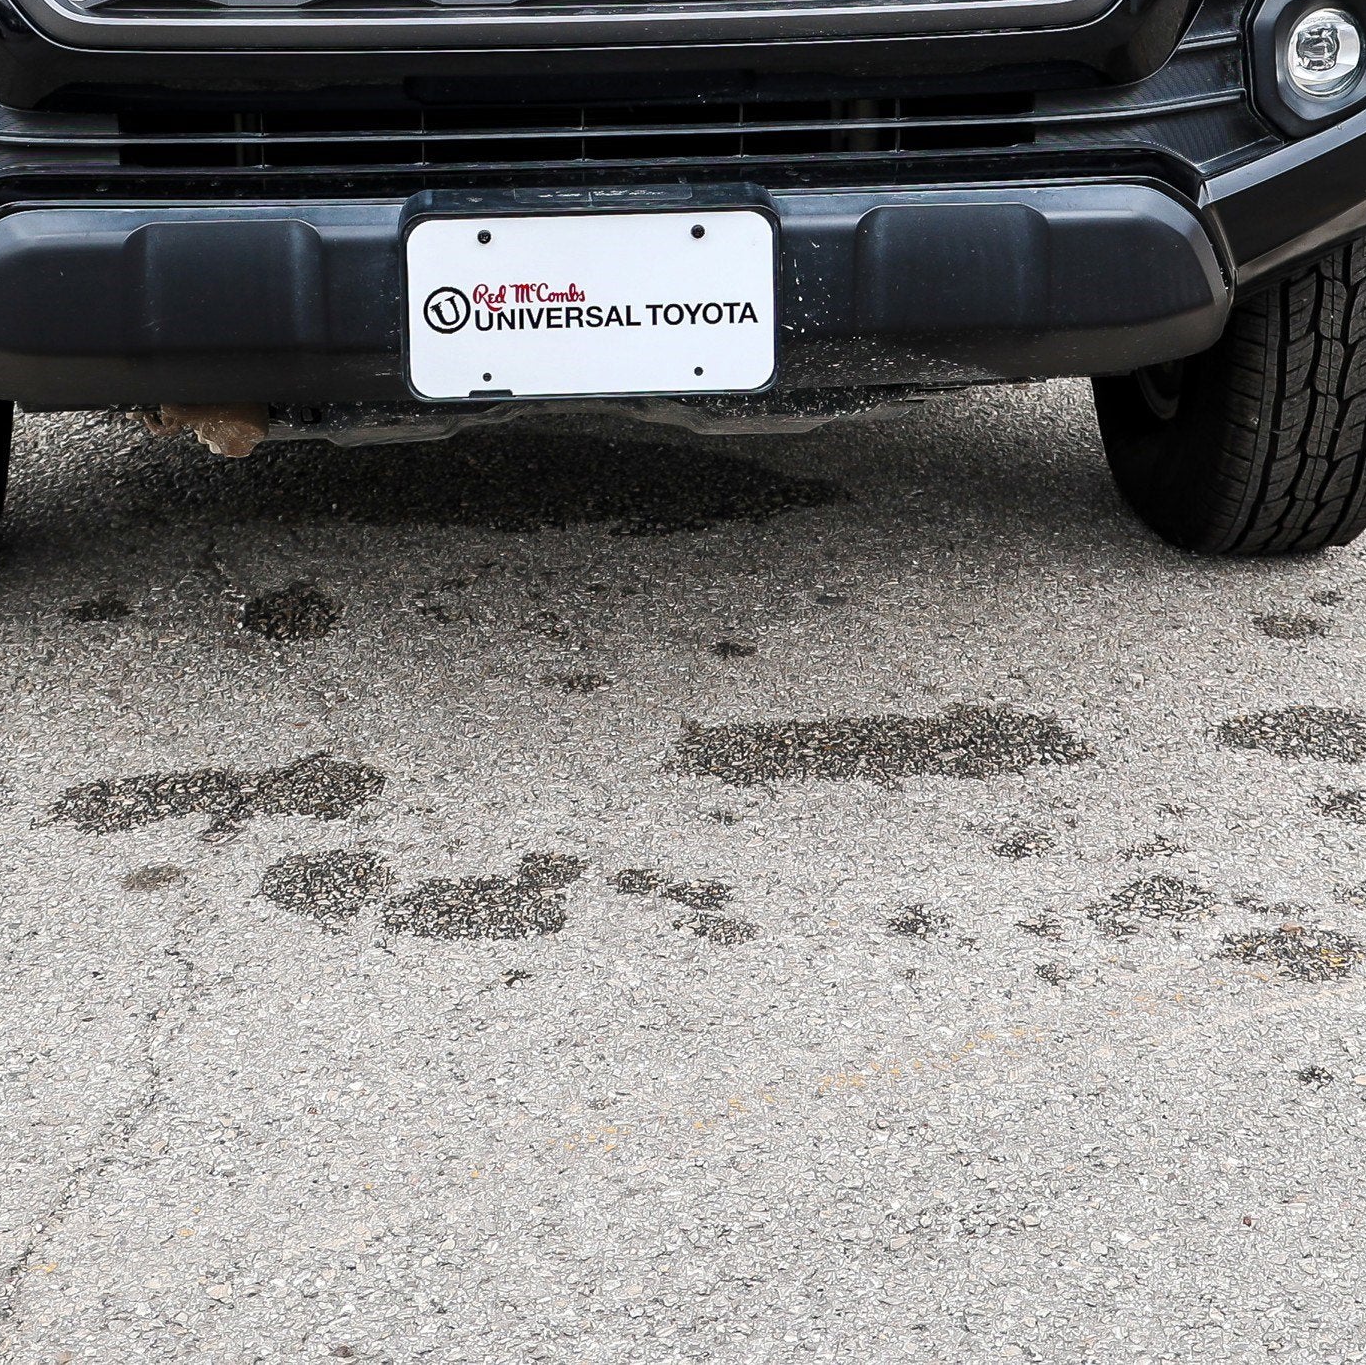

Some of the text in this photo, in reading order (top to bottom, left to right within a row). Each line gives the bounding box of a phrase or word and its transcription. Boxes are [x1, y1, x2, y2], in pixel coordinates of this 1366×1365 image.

[473, 282, 586, 311] Red McCombs
[474, 302, 760, 332] UNIVERSAL TOYOTA
